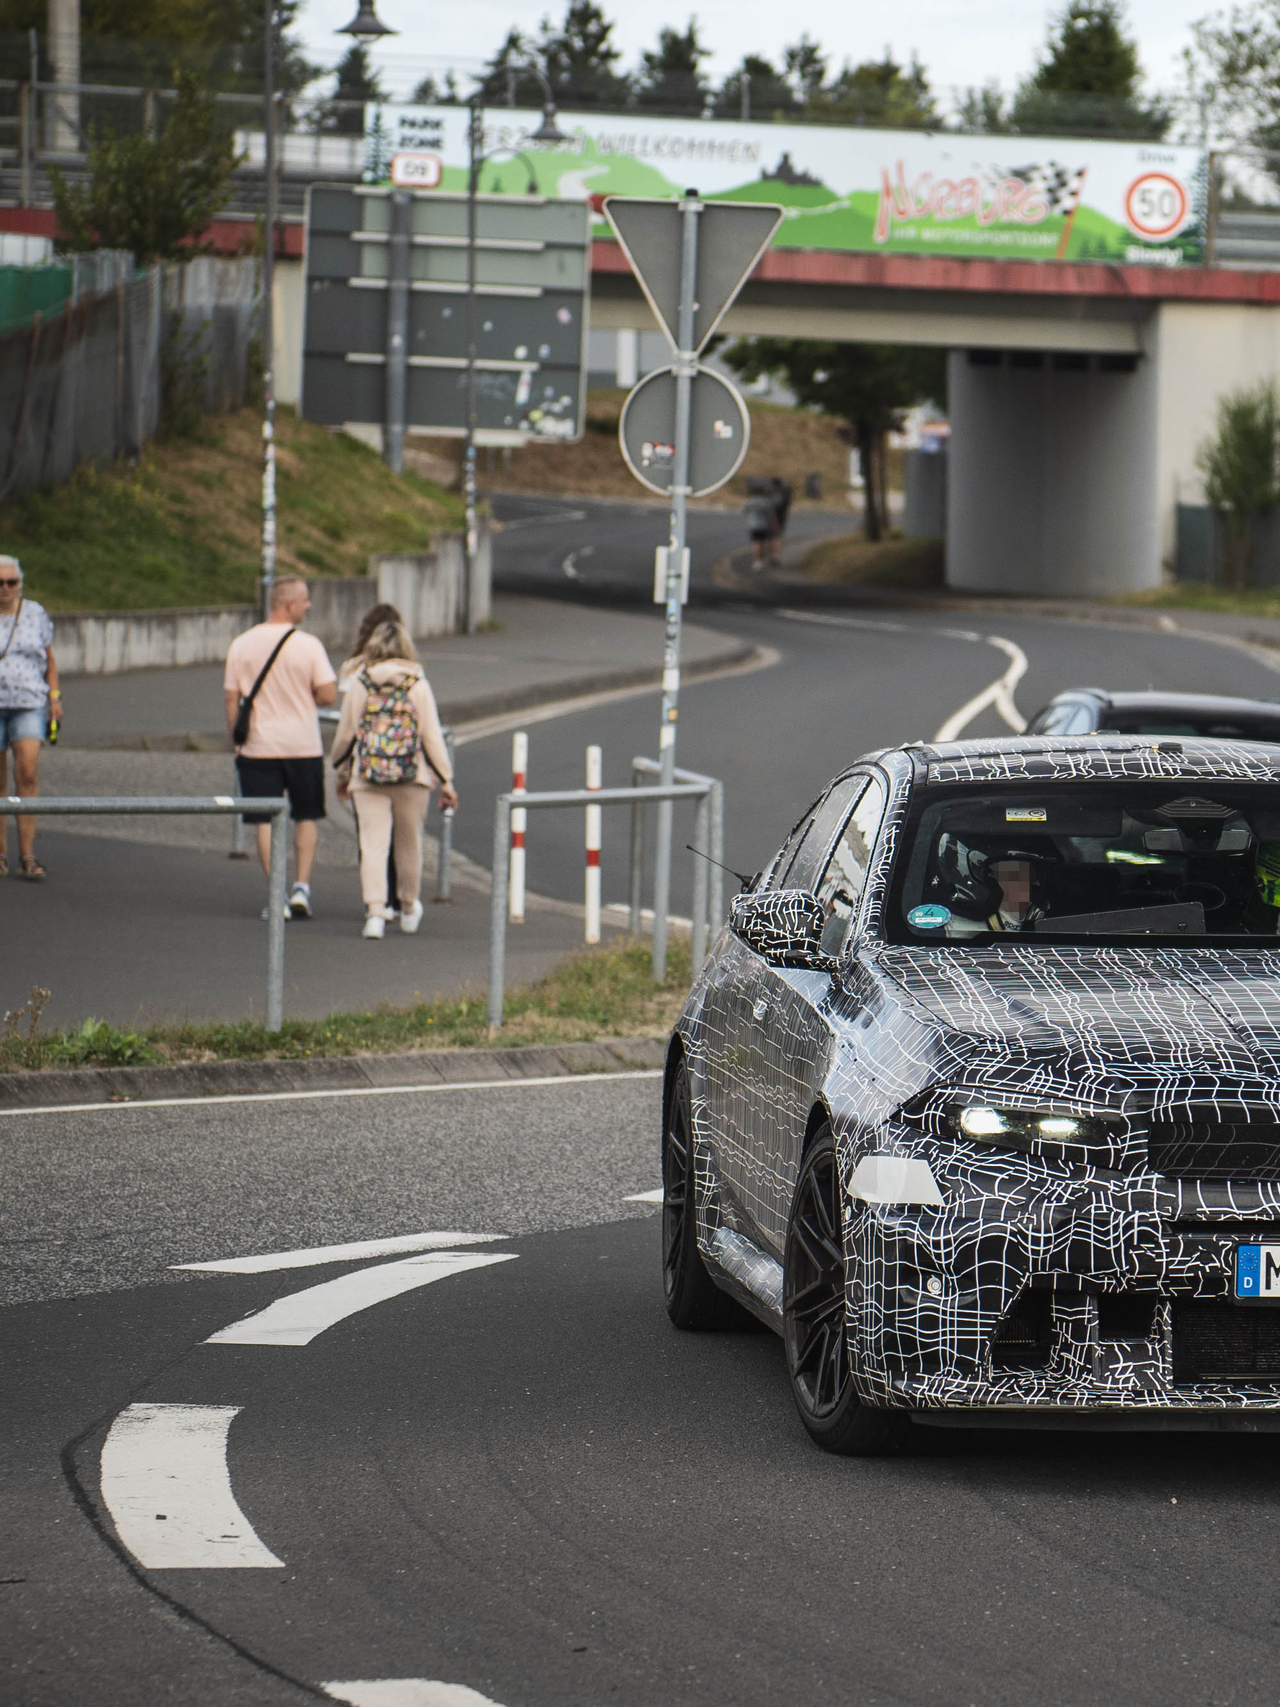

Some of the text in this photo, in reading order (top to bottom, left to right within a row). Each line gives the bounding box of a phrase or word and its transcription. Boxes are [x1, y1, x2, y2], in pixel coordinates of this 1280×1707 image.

[399, 116, 443, 130] PARK
[398, 134, 443, 149] ZONE
[596, 131, 760, 162] WILLKOMMEN
[1138, 189, 1176, 219] 50
[924, 907, 935, 917] 4
[1243, 1277, 1253, 1289] D
